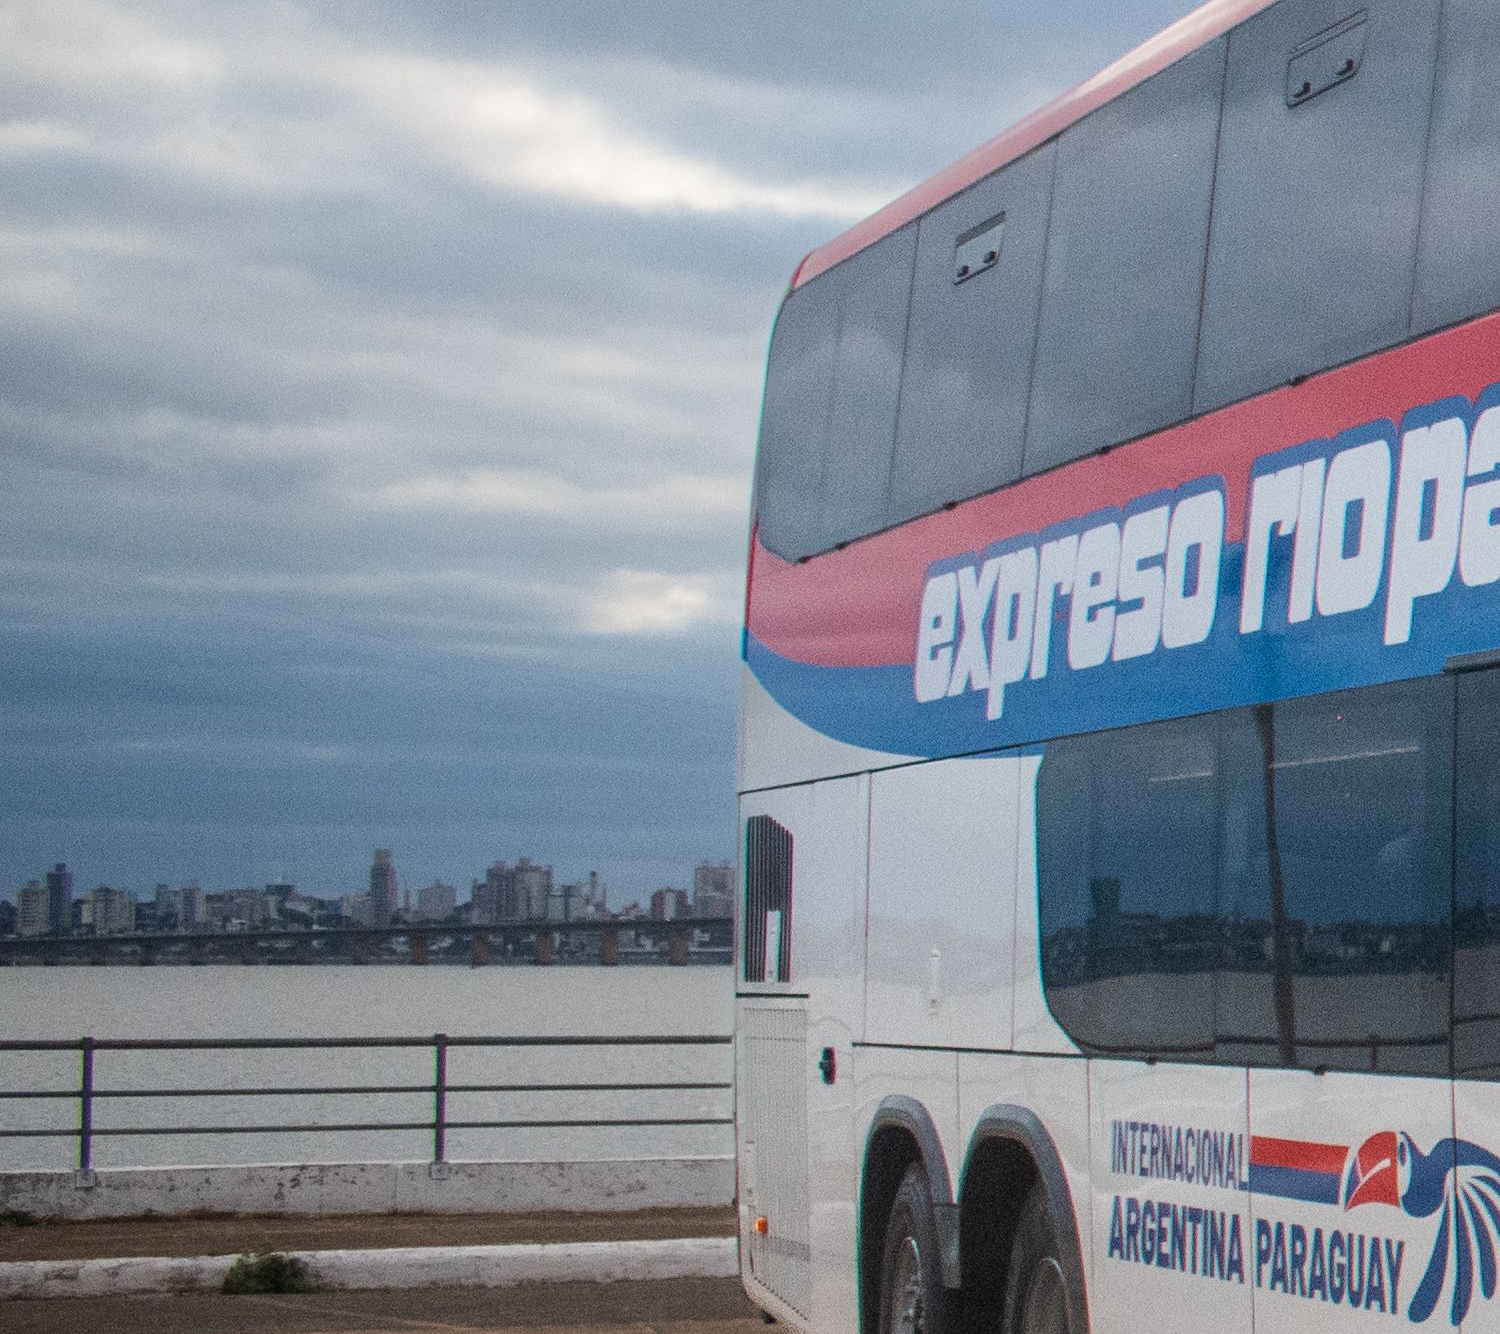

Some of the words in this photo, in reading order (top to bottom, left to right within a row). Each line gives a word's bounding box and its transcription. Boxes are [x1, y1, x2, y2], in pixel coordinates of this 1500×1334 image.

[913, 488, 1226, 721] expreso
[1110, 1119, 1250, 1192] INTERNACIONAL
[1107, 1194, 1245, 1285] ARGENTINA
[1255, 1217, 1405, 1316] PARAGUAY
